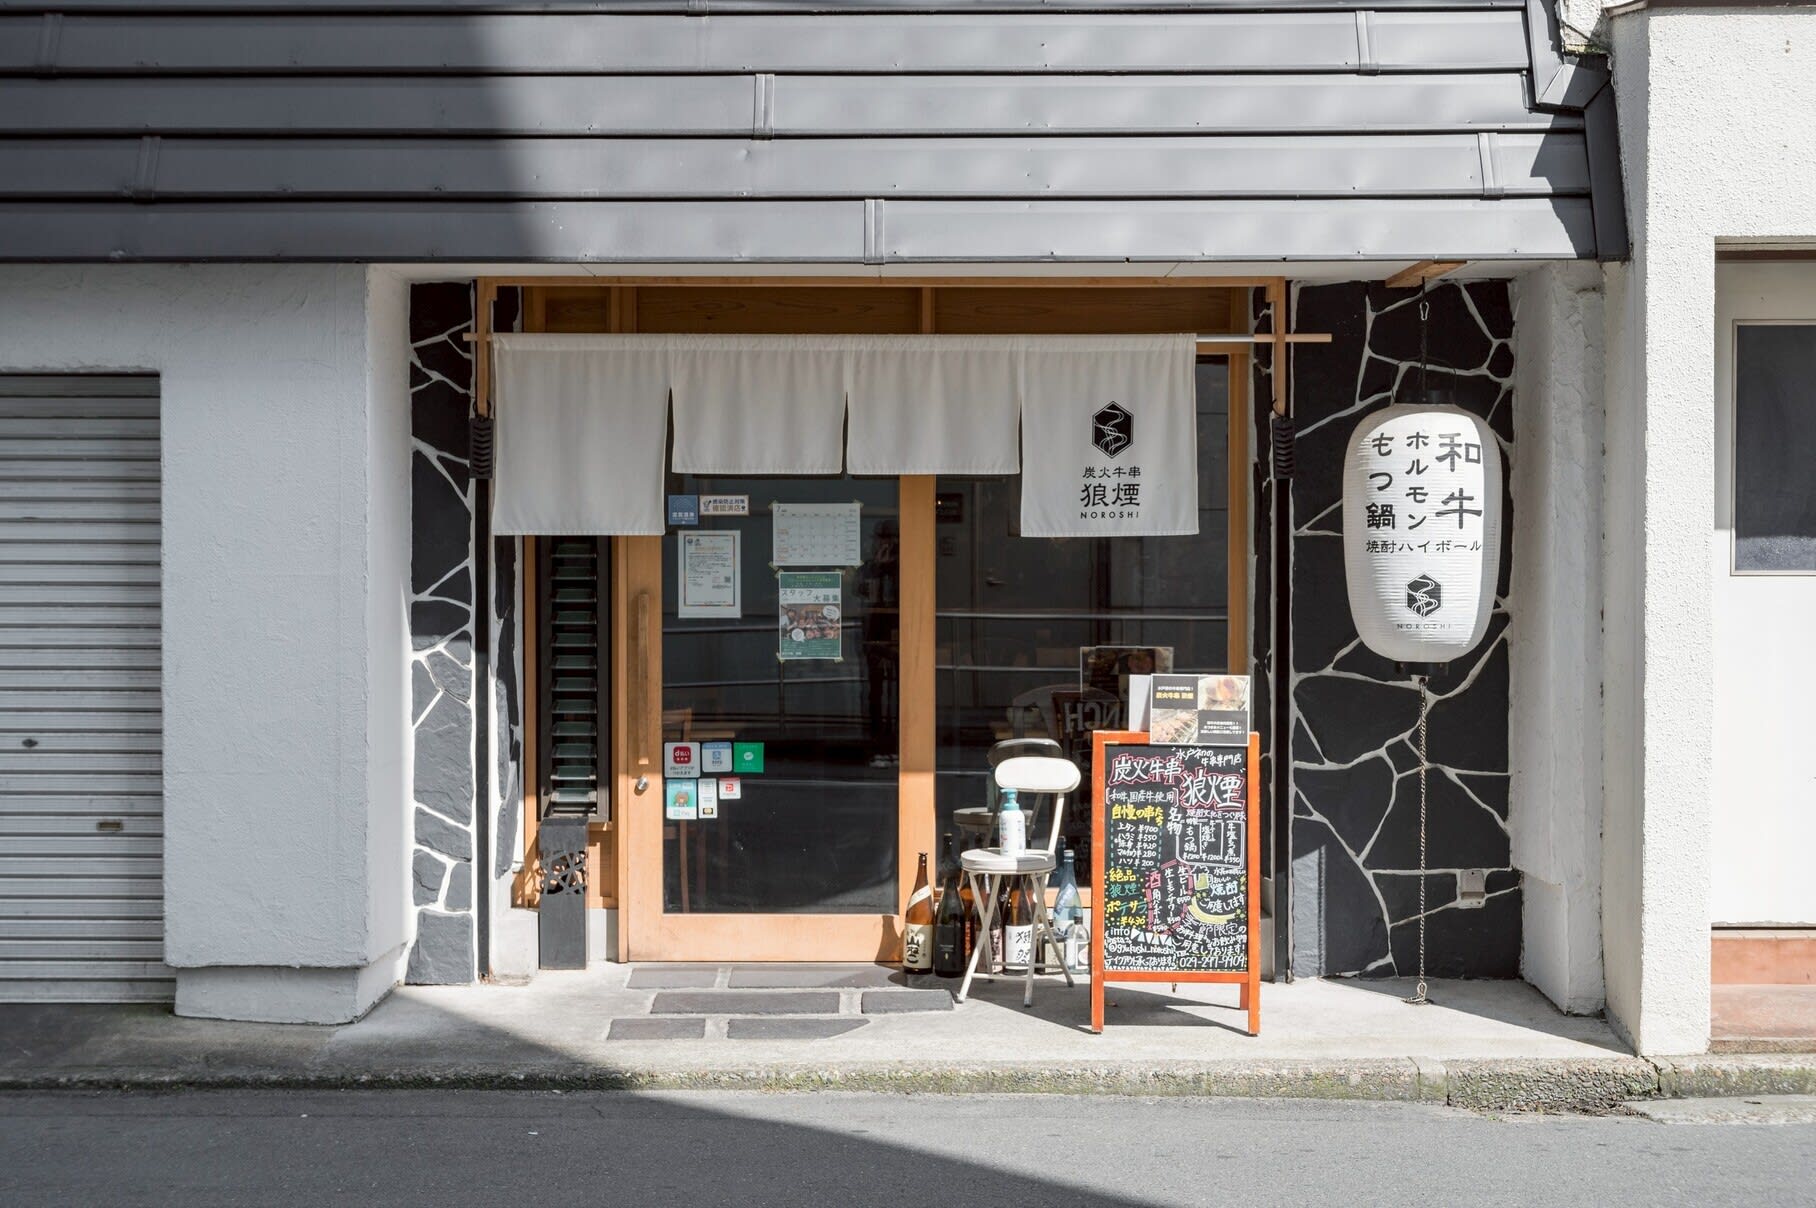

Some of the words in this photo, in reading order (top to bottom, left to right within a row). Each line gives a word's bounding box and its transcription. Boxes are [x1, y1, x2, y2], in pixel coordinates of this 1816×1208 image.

[1082, 465, 1141, 479] 炭火牛串
[1405, 431, 1429, 530] ホルモン
[1365, 432, 1396, 530] もつ鍋
[1435, 432, 1482, 530] 和牛
[1080, 483, 1141, 508] 狼煙
[1080, 511, 1139, 519] NOROSHI
[1366, 540, 1482, 554] 焼酎ハイボール
[1112, 756, 1182, 783] 炭火牛串
[1182, 769, 1243, 808] 狼煙
[1112, 804, 1164, 826] 自慢の串たち
[1167, 807, 1183, 835] 名物
[1117, 822, 1136, 832] 上タン
[1138, 824, 1158, 833] ¥700
[1137, 834, 1157, 842] ¥550
[1184, 826, 1198, 853] もつ鍋
[1137, 850, 1156, 858] ¥280
[1134, 859, 1154, 867] ¥200
[1109, 868, 1137, 882] 絶品
[1145, 870, 1161, 889] 酒
[1177, 866, 1189, 896] 生ビール
[1210, 880, 1239, 897] 焼酎
[1106, 900, 1147, 915] ポテサラ
[1120, 916, 1145, 926] ¥430
[1179, 956, 1245, 968] 029-297-9909
